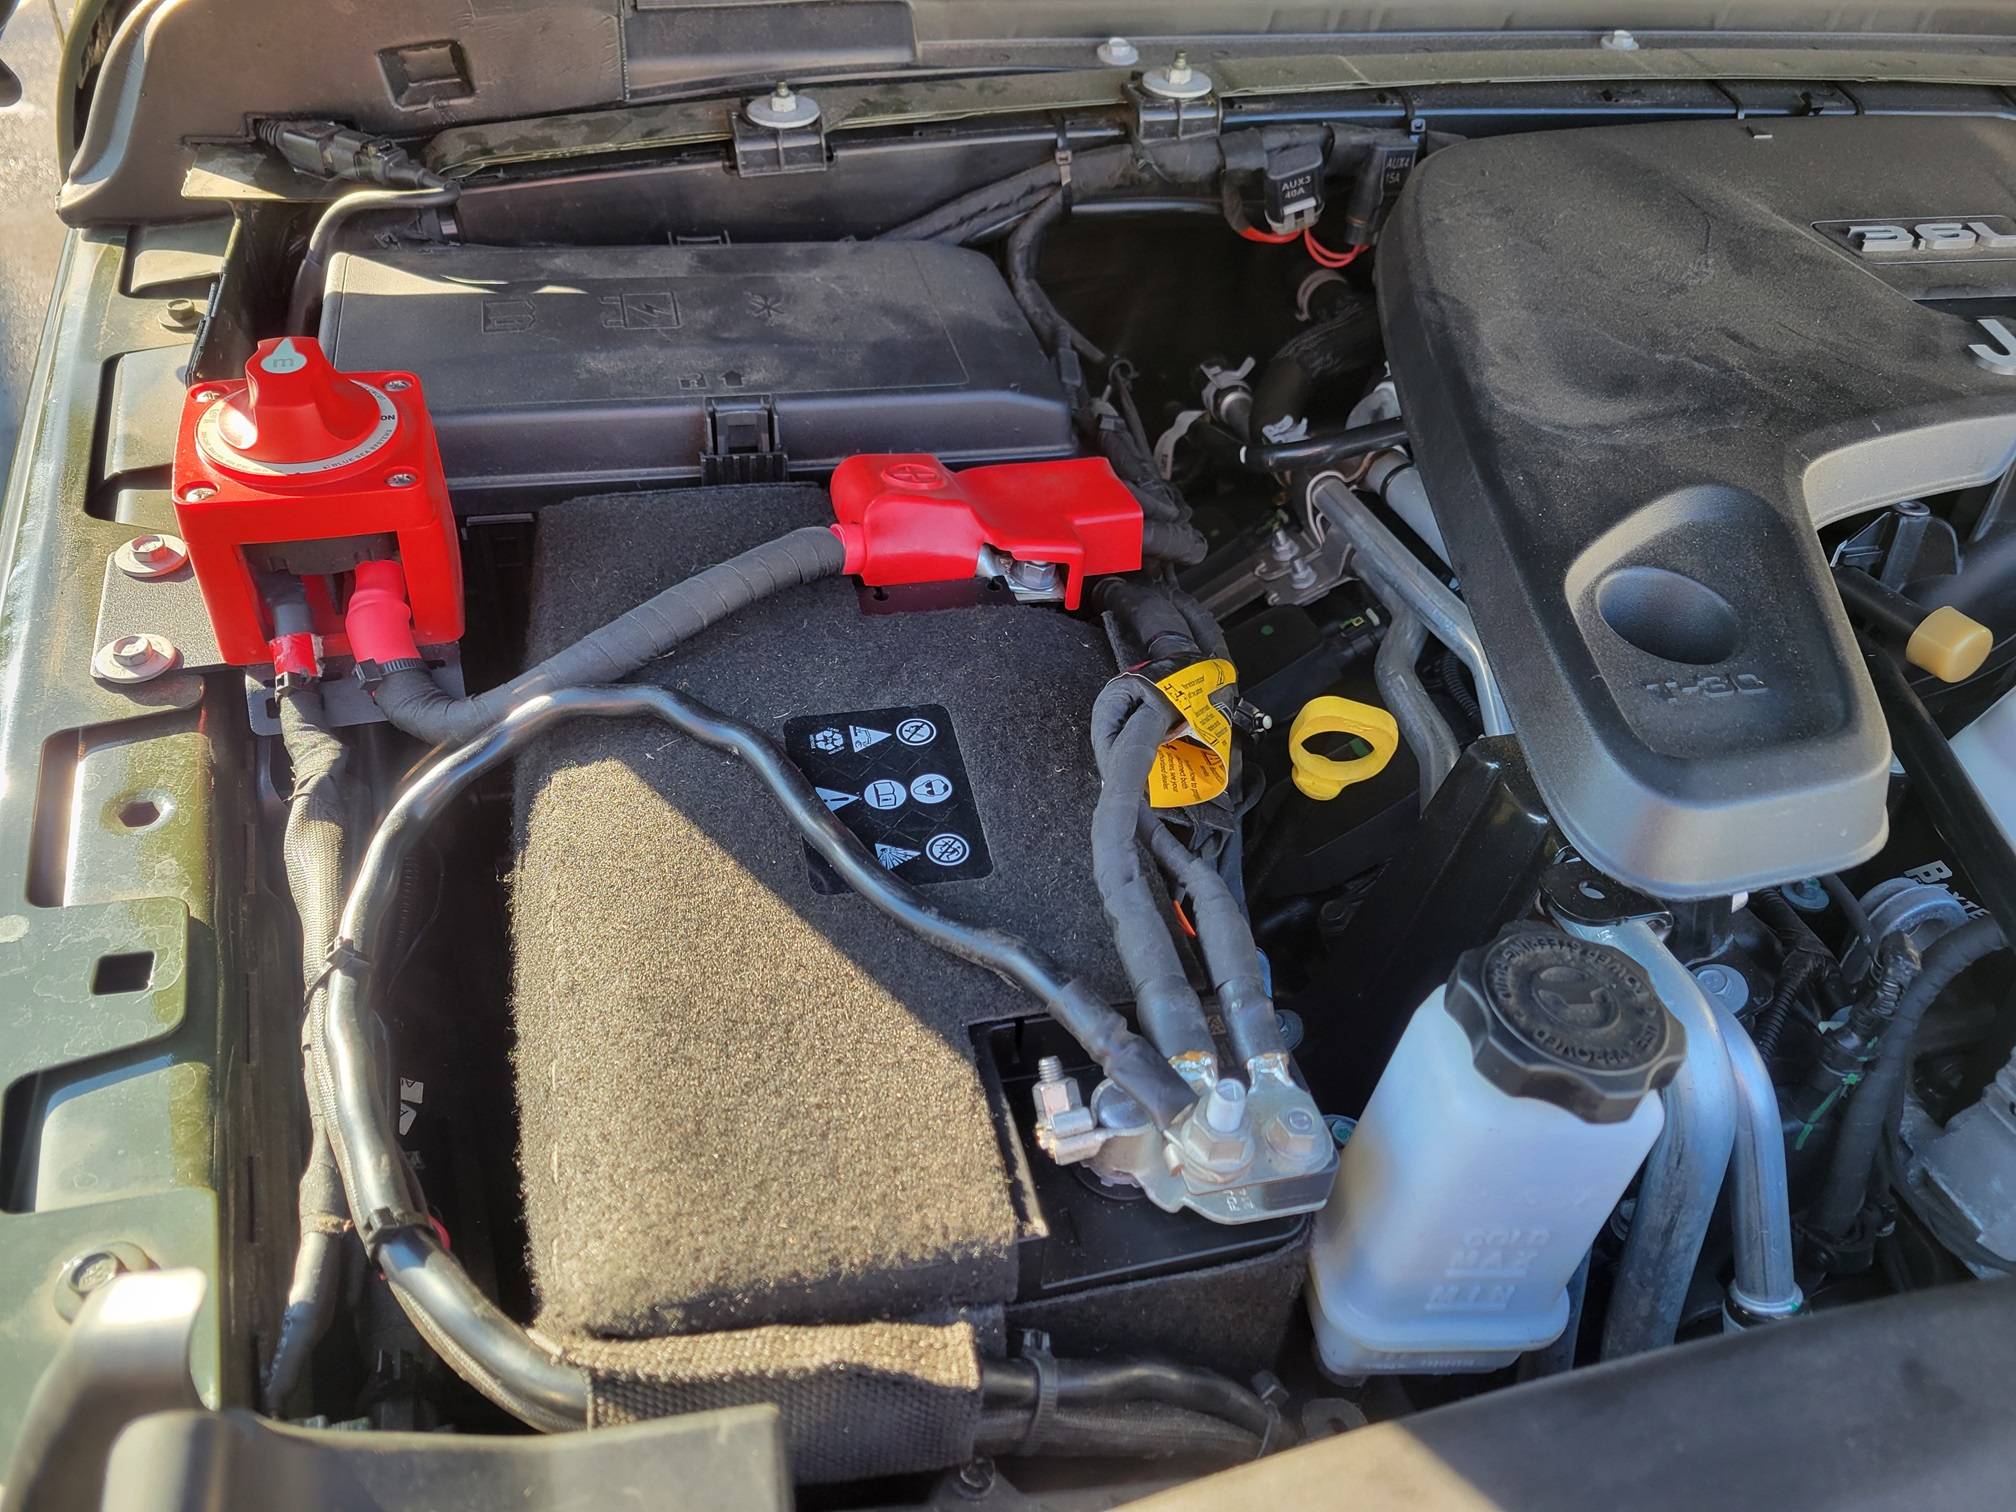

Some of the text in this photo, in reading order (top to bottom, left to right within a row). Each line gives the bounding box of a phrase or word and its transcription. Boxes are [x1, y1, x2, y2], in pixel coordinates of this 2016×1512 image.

[1281, 175, 1312, 192] AUX3
[1284, 187, 1305, 199] 40A
[1587, 949, 1650, 1001] POWER
[1430, 1284, 1516, 1302] MIN
